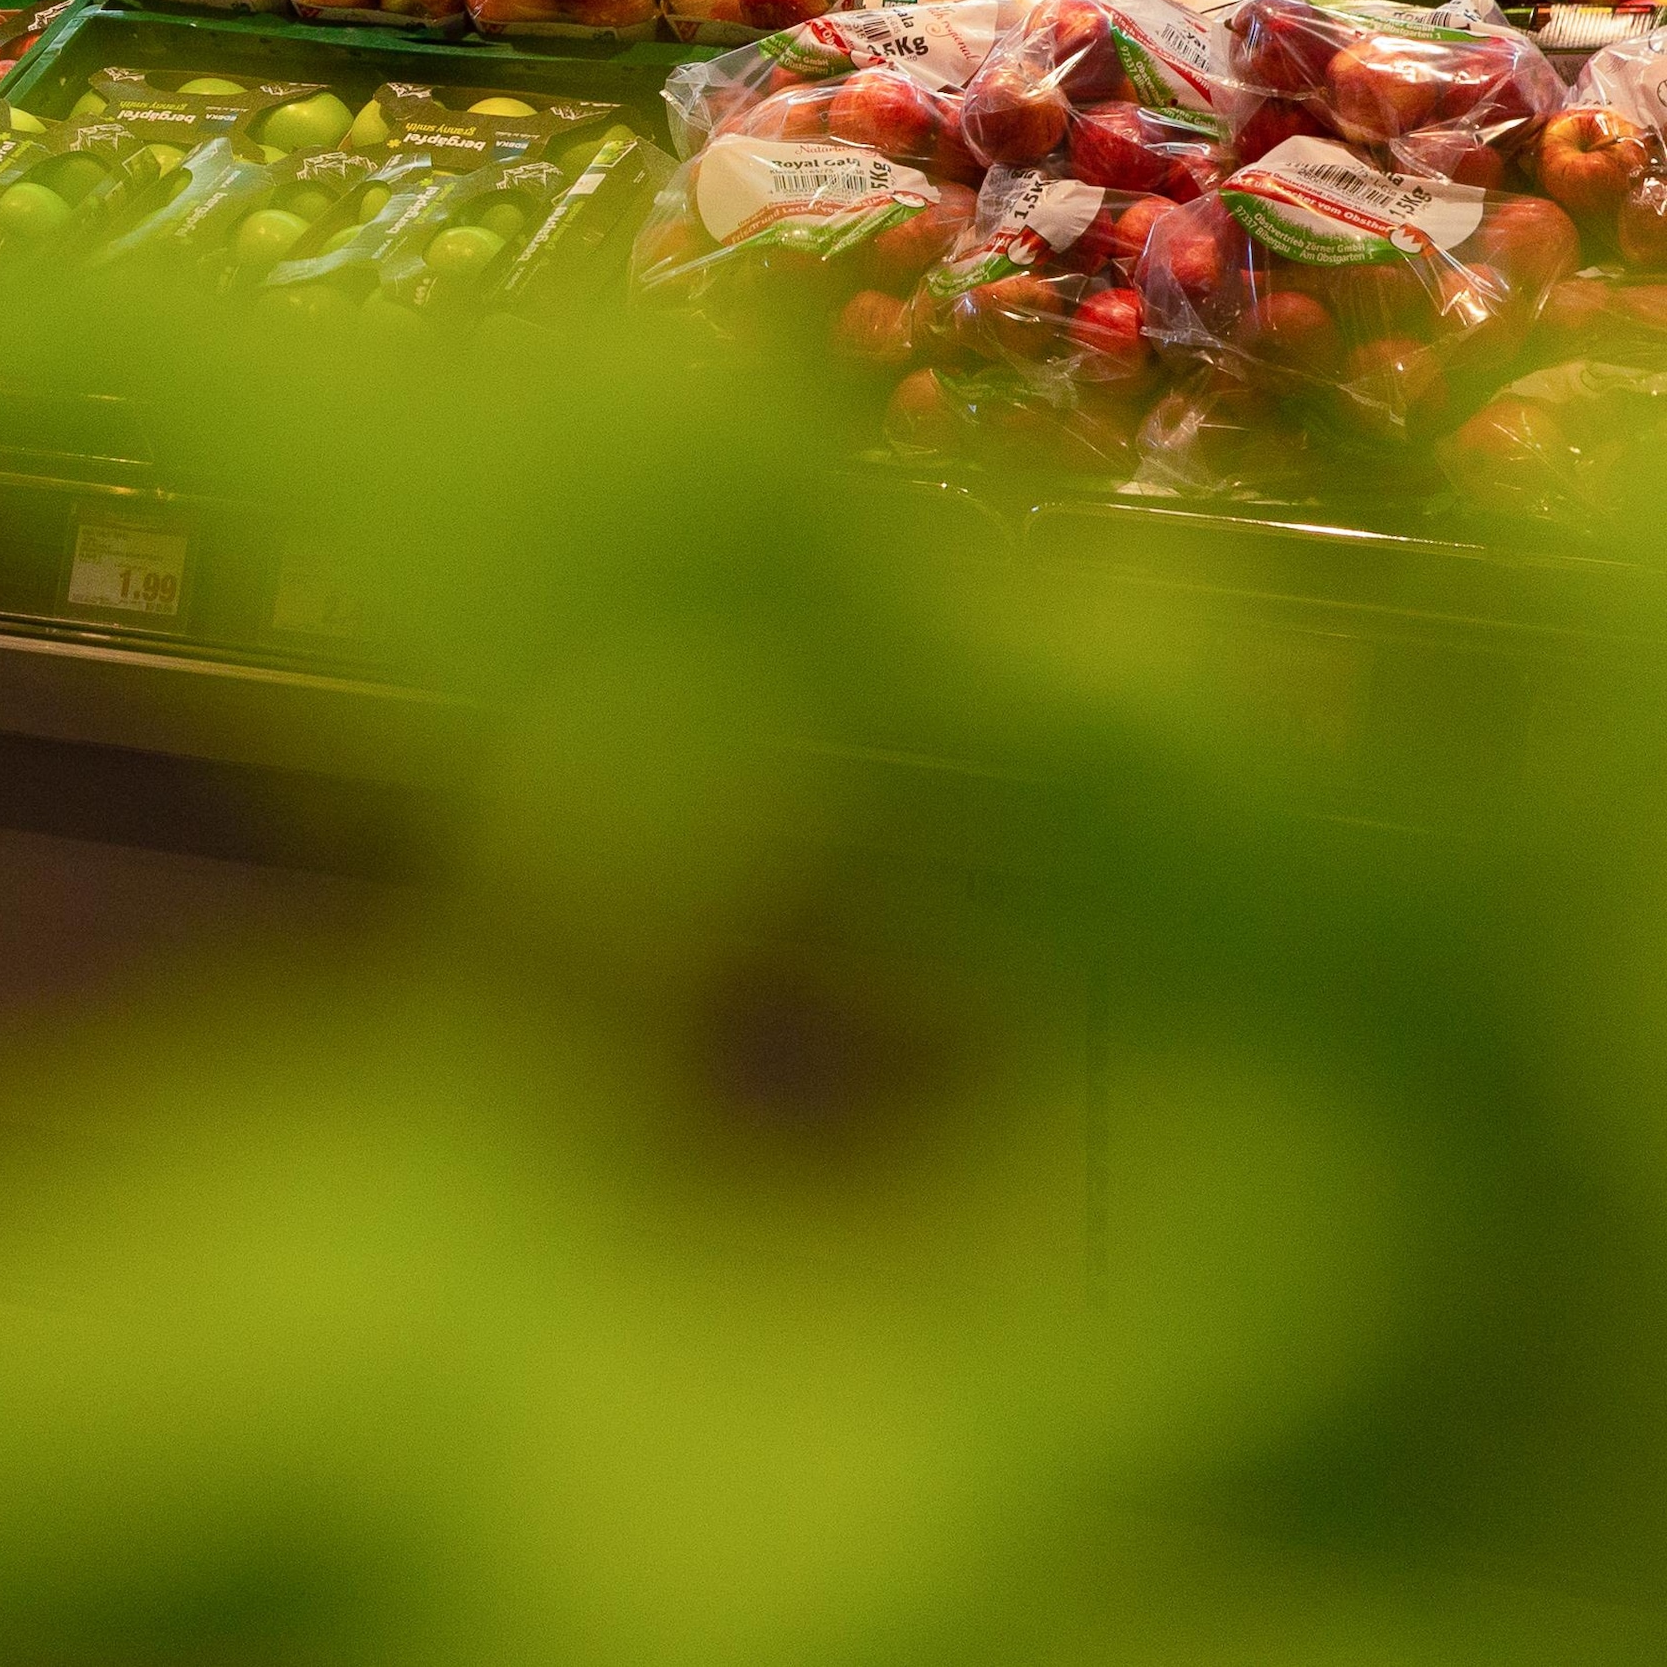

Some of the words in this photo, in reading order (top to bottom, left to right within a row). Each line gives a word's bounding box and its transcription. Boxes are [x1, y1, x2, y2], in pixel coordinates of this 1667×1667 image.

[895, 9, 915, 29] ala
[402, 132, 486, 152] bergäpfel
[1317, 201, 1341, 216] vom
[1234, 204, 1256, 229] 97337
[1254, 226, 1291, 254] Bibergau
[1299, 249, 1315, 260] Am
[1317, 250, 1366, 265] Obstgarten
[1253, 211, 1304, 249] Obstvertrieb
[1337, 241, 1366, 253] GmbH
[119, 569, 177, 603] 1.99
